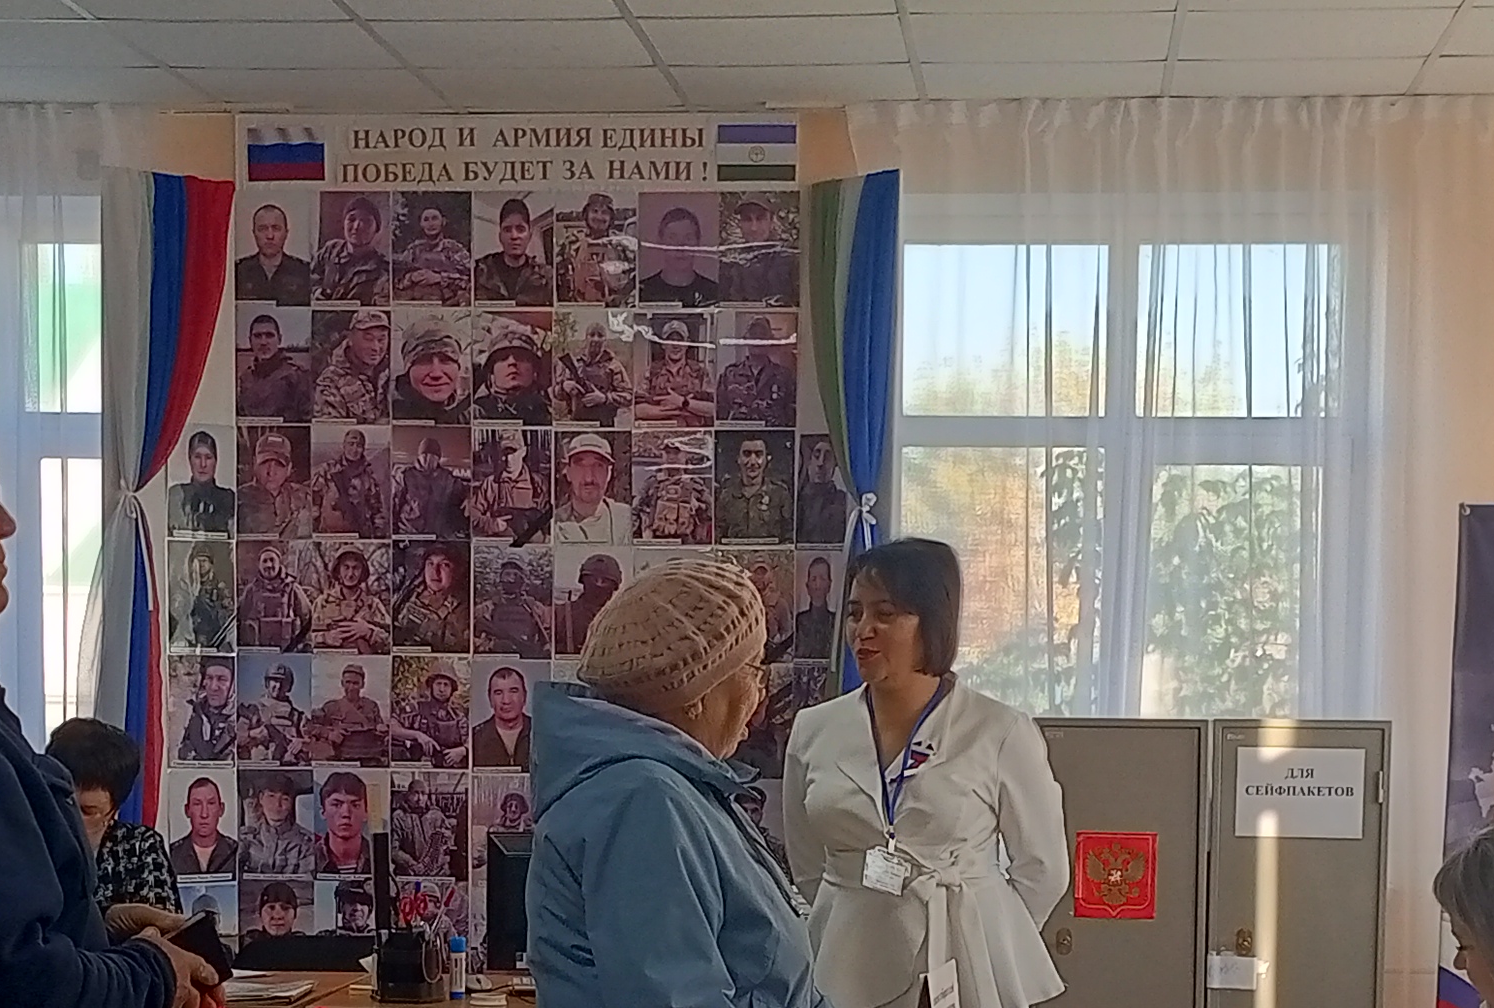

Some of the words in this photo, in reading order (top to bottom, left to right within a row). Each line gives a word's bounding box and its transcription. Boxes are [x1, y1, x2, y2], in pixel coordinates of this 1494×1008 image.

[352, 127, 446, 152] НАРОД
[457, 127, 477, 149] И
[492, 126, 591, 150] АРМИЯ
[601, 126, 705, 152] ЕДИНЫ
[342, 161, 454, 185] ПОБЕДА
[462, 160, 554, 184] БУДЕТ
[562, 160, 596, 182] ЗА
[608, 160, 692, 182] НАМИ
[1284, 767, 1315, 781] ДЛЯ
[1245, 782, 1355, 798] СЕЙФПАКЕТОВ
